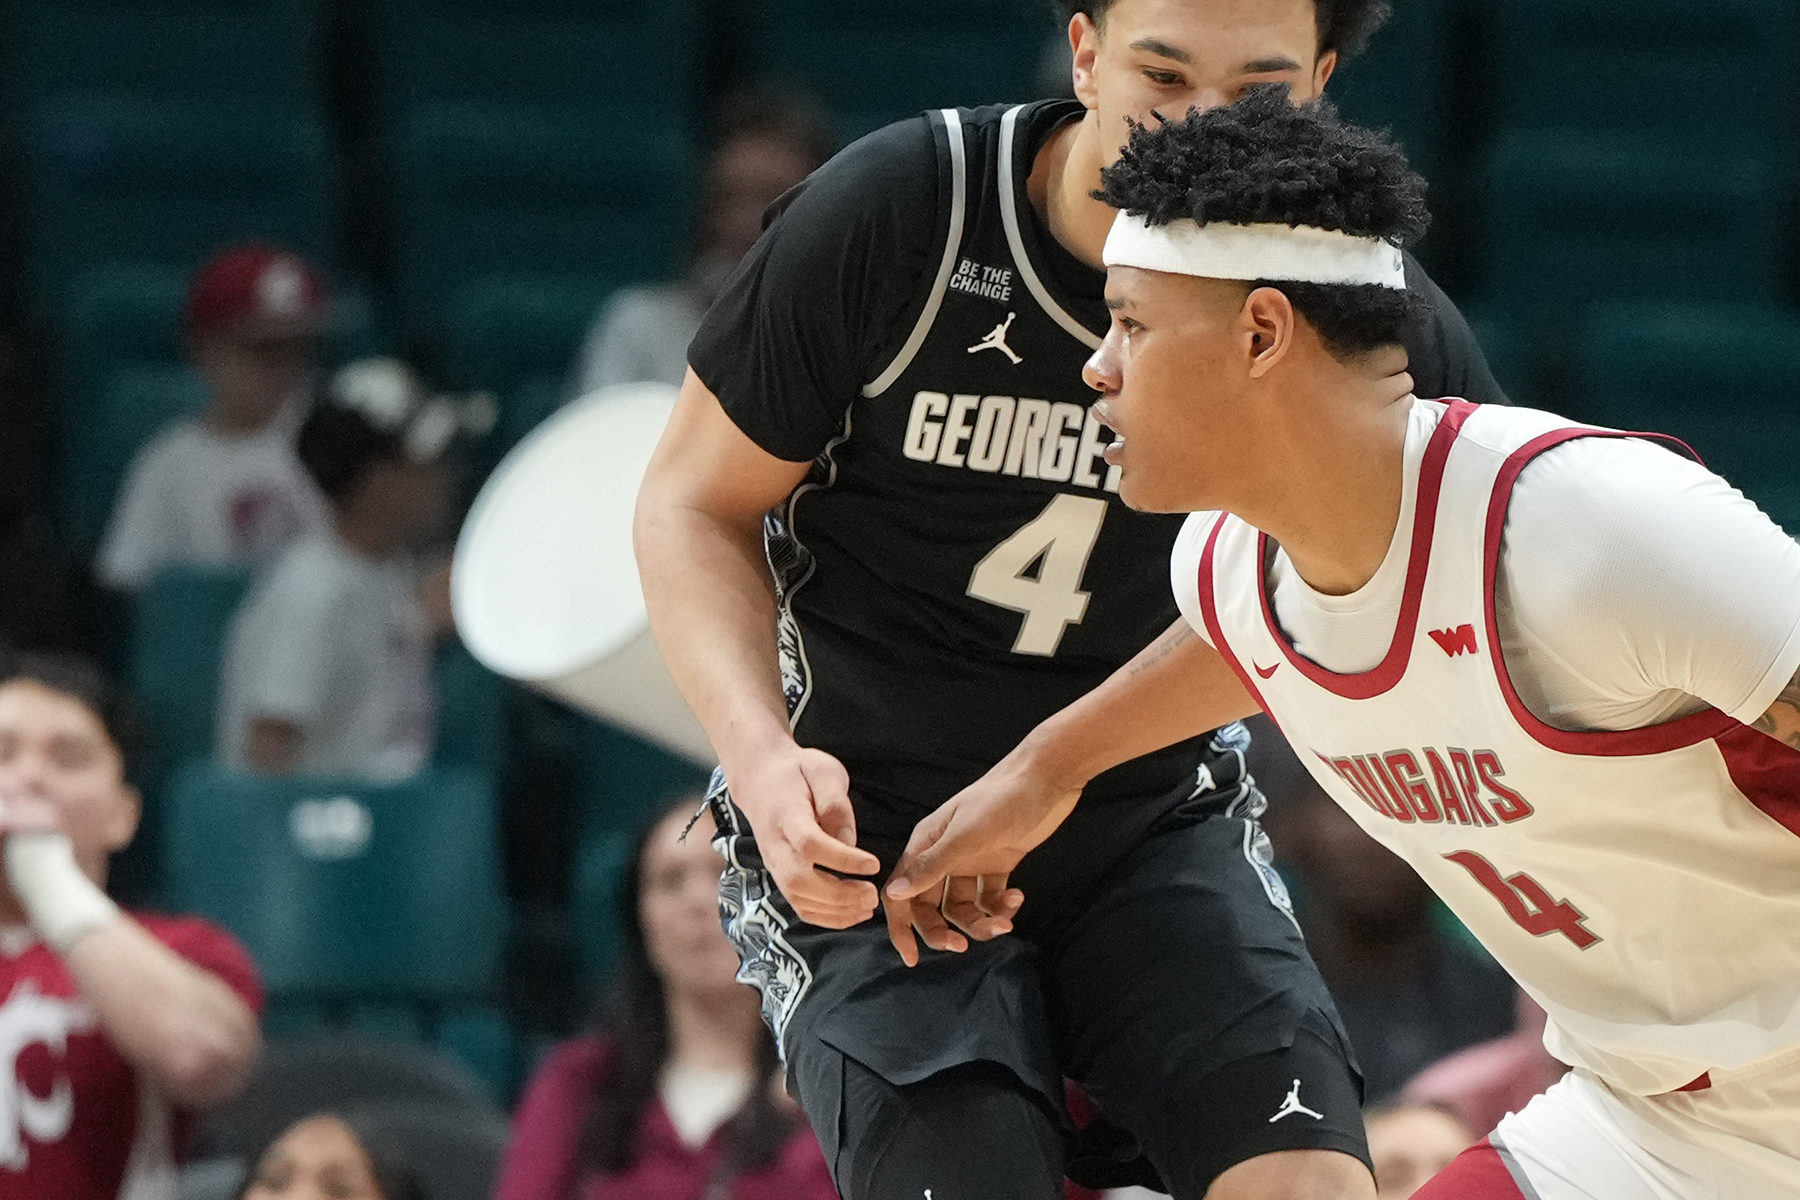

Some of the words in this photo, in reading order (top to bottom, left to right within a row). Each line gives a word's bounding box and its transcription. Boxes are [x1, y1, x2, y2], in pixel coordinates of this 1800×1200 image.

[949, 273, 1012, 302] CHANGE
[958, 259, 980, 278] BE
[982, 266, 1012, 286] THE
[965, 492, 1110, 658] 4
[1436, 849, 1605, 951] 4
